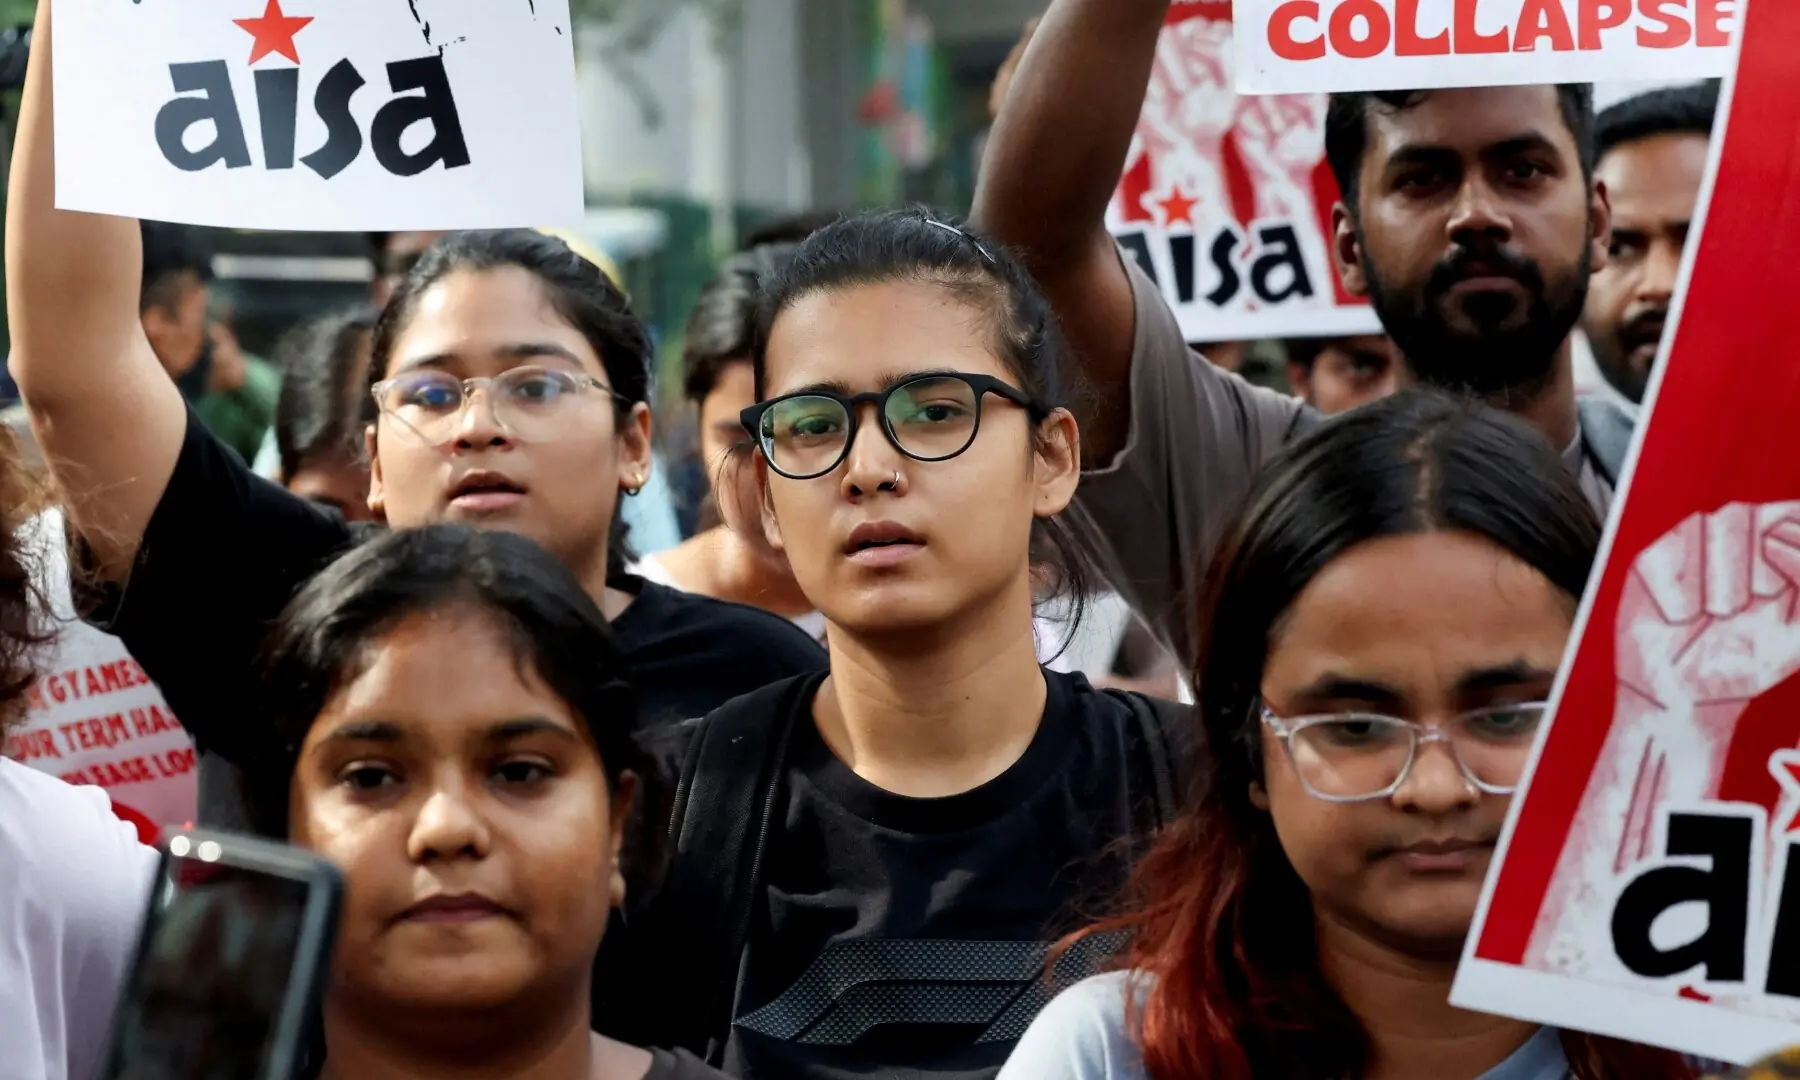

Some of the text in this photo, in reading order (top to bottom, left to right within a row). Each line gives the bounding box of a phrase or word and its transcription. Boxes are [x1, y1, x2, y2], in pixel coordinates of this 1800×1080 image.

[1267, 0, 1734, 60] COLLAPSE
[155, 55, 471, 180] aisa
[58, 713, 131, 751] TERM
